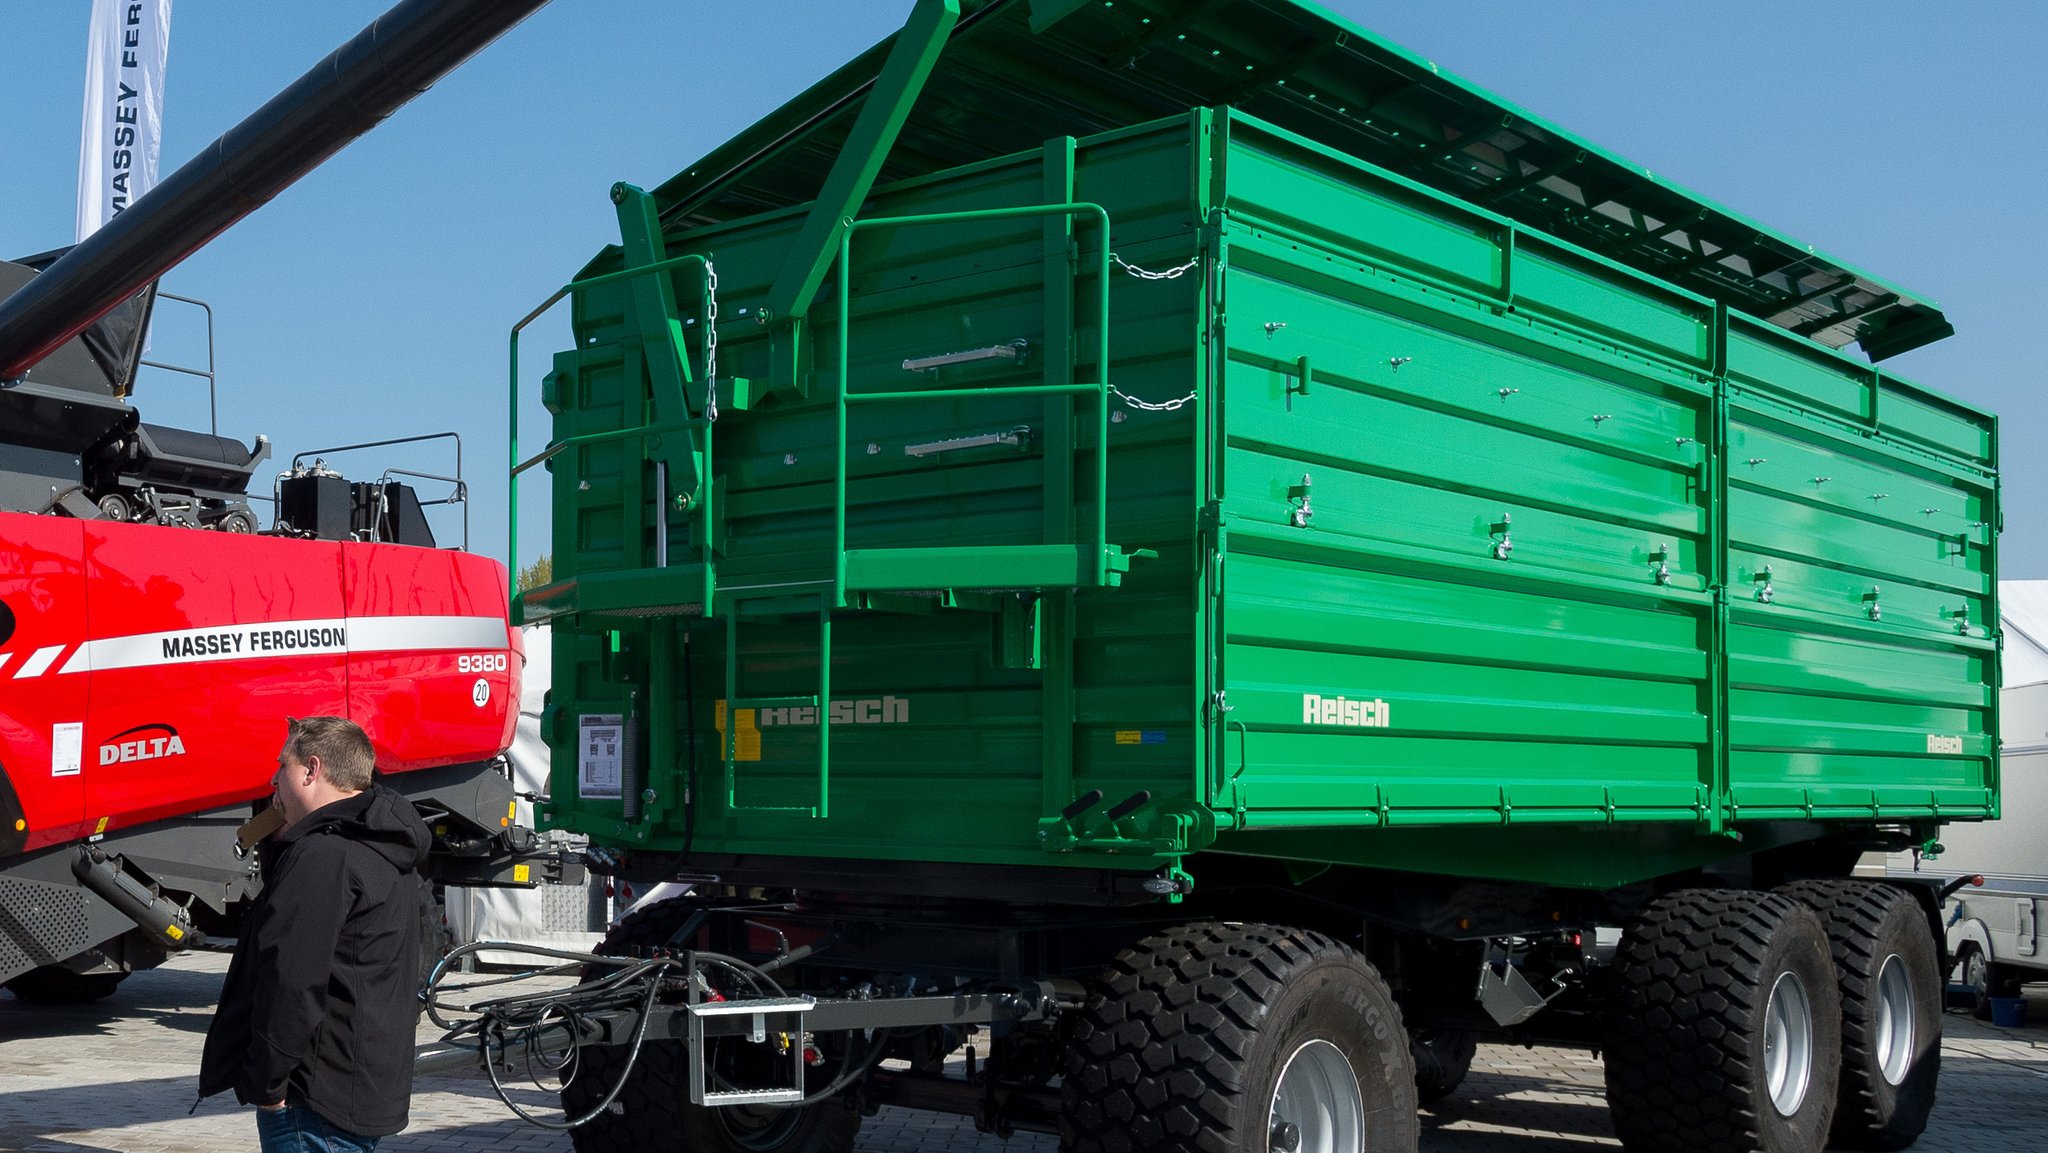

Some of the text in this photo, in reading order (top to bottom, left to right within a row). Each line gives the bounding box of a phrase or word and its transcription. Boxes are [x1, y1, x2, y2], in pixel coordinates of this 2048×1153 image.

[112, 0, 142, 219] MASSEY FER
[162, 627, 346, 659] MASSEY FERGUSON
[457, 653, 507, 673] 9380
[475, 683, 488, 702] 20
[762, 696, 908, 725] Resch
[1303, 693, 1390, 728] Reisch
[99, 735, 187, 766] DELTA
[1927, 733, 1963, 754] Reisch
